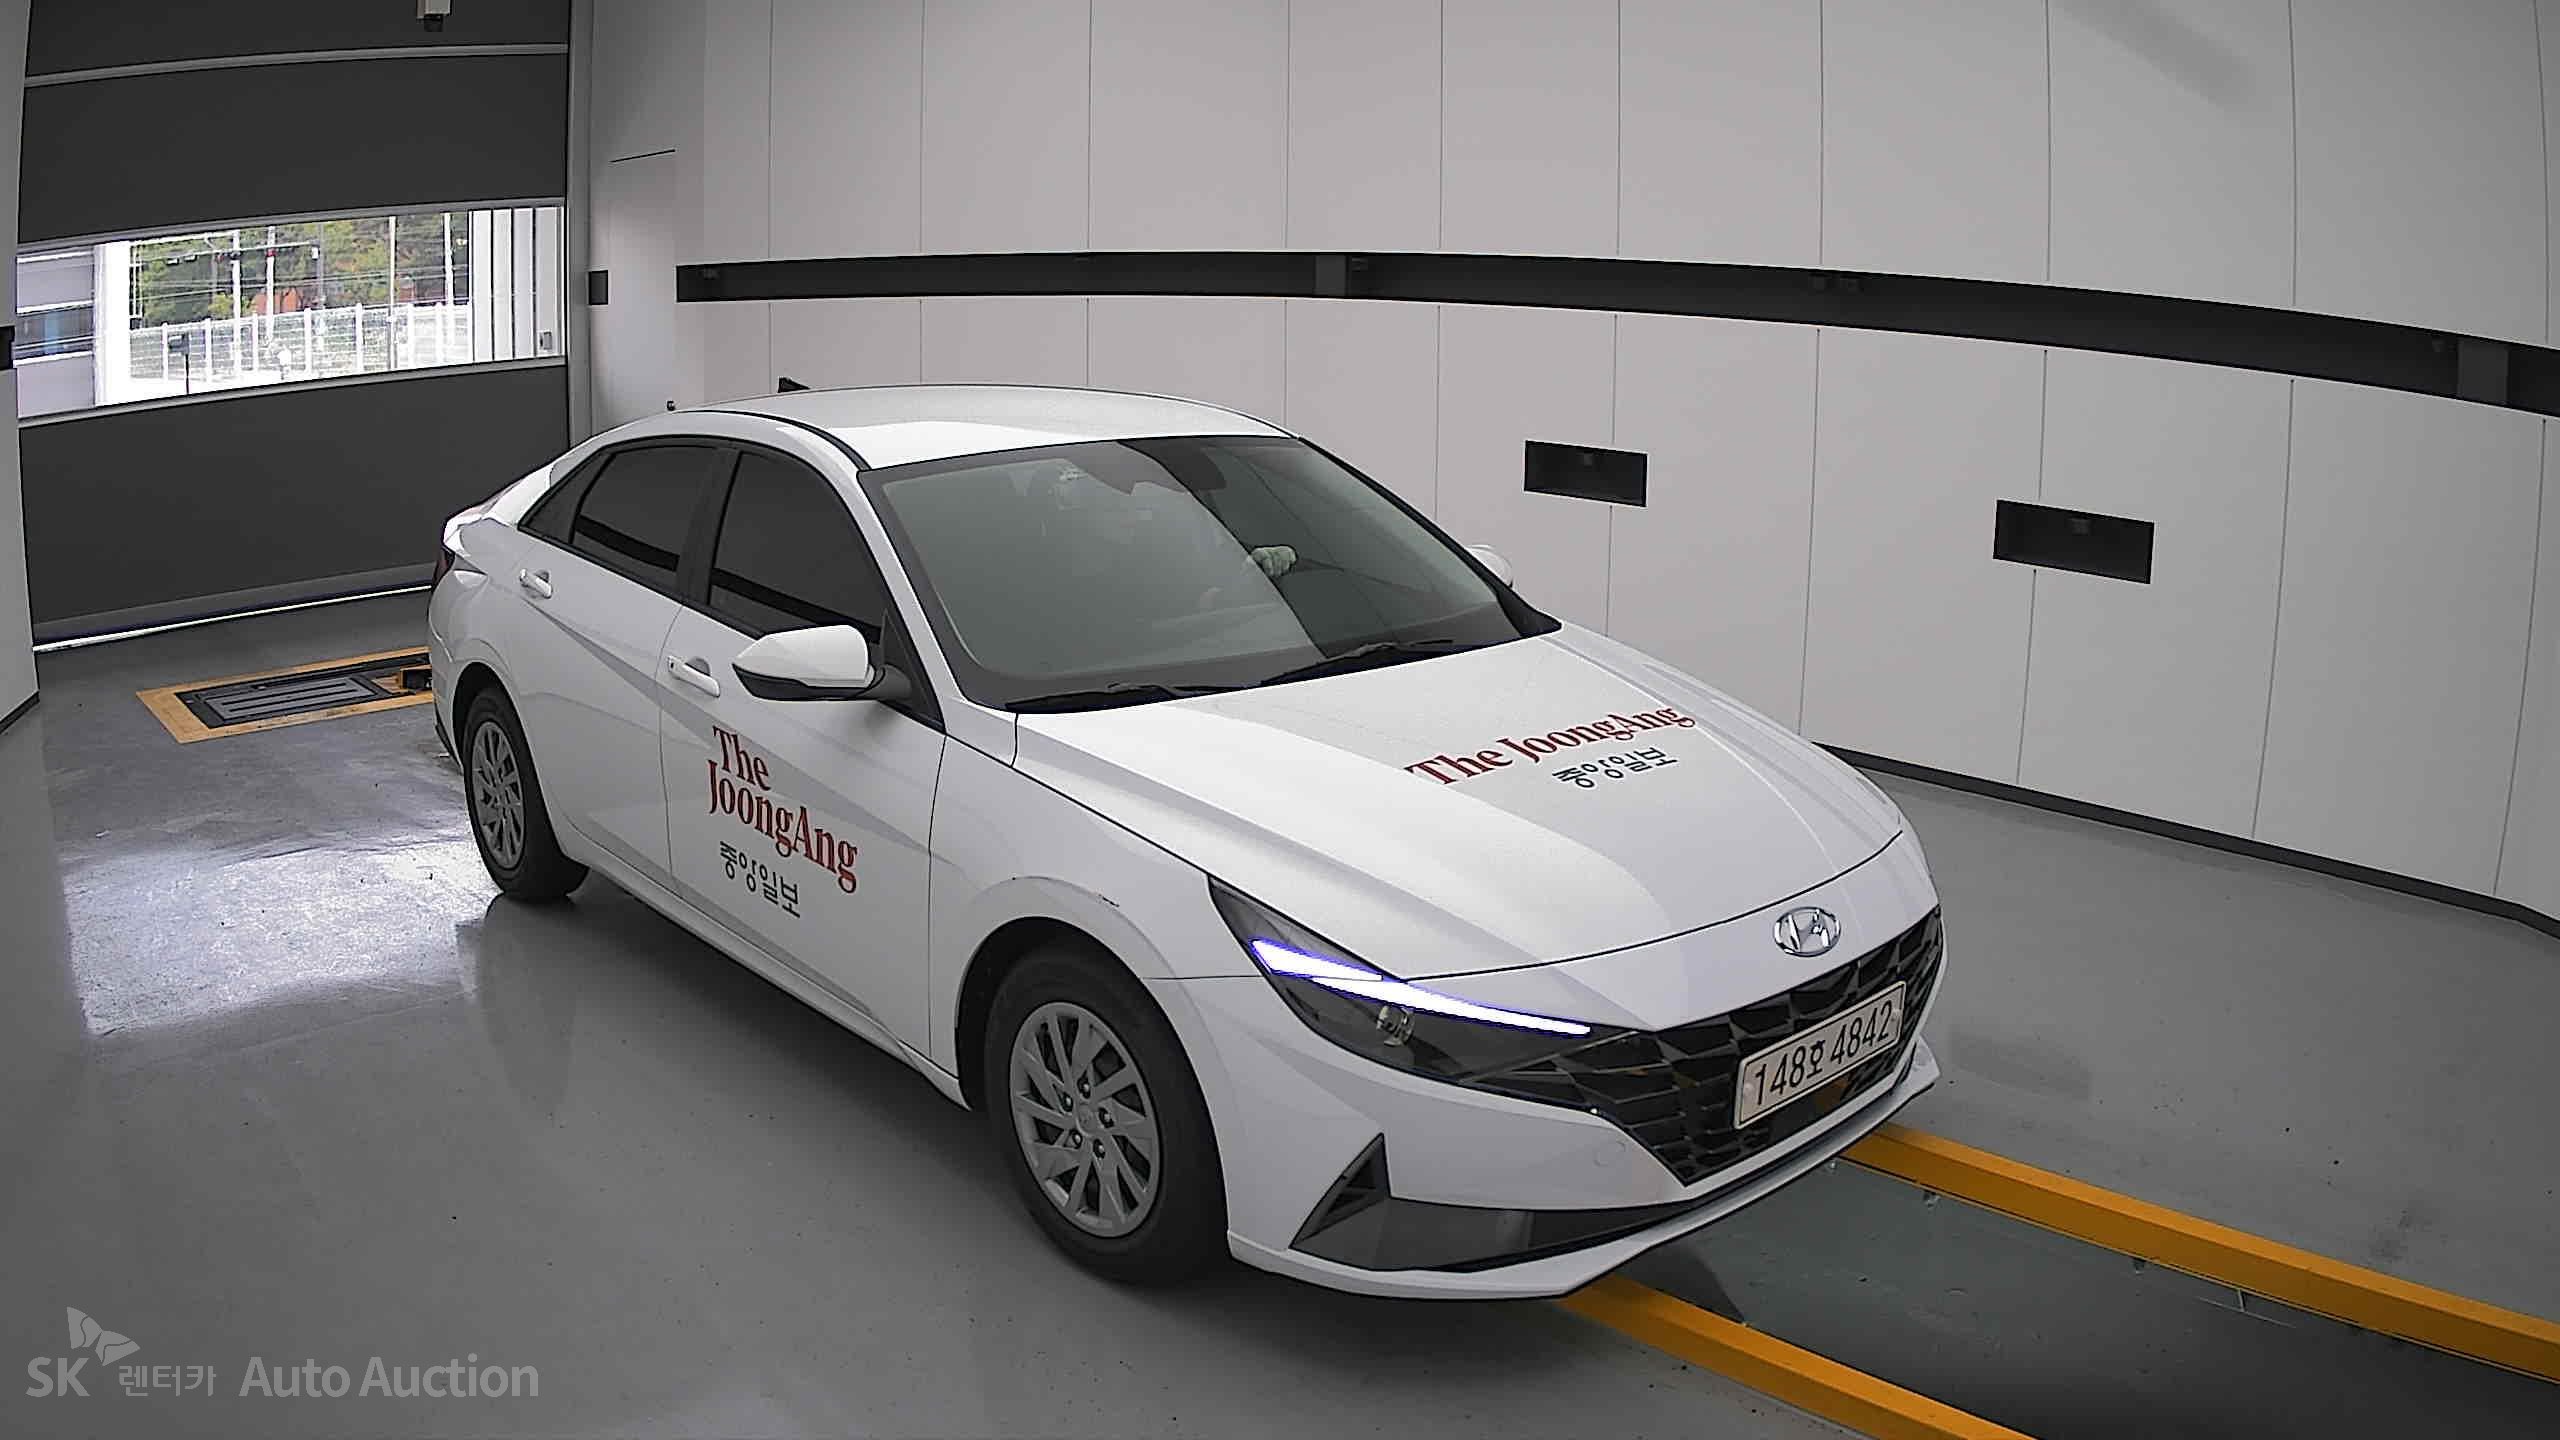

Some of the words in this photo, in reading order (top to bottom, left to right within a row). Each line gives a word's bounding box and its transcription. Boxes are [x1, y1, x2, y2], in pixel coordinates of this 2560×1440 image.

[712, 725, 771, 791] The
[1404, 749, 1513, 785] The
[1496, 706, 1696, 763] JoongAng
[1552, 746, 1677, 788] 중앙일보
[708, 759, 857, 893] JoongAng
[720, 841, 800, 918] 중앙일보
[1755, 1039, 1826, 1105] 148호
[1830, 1000, 1892, 1064] 4842
